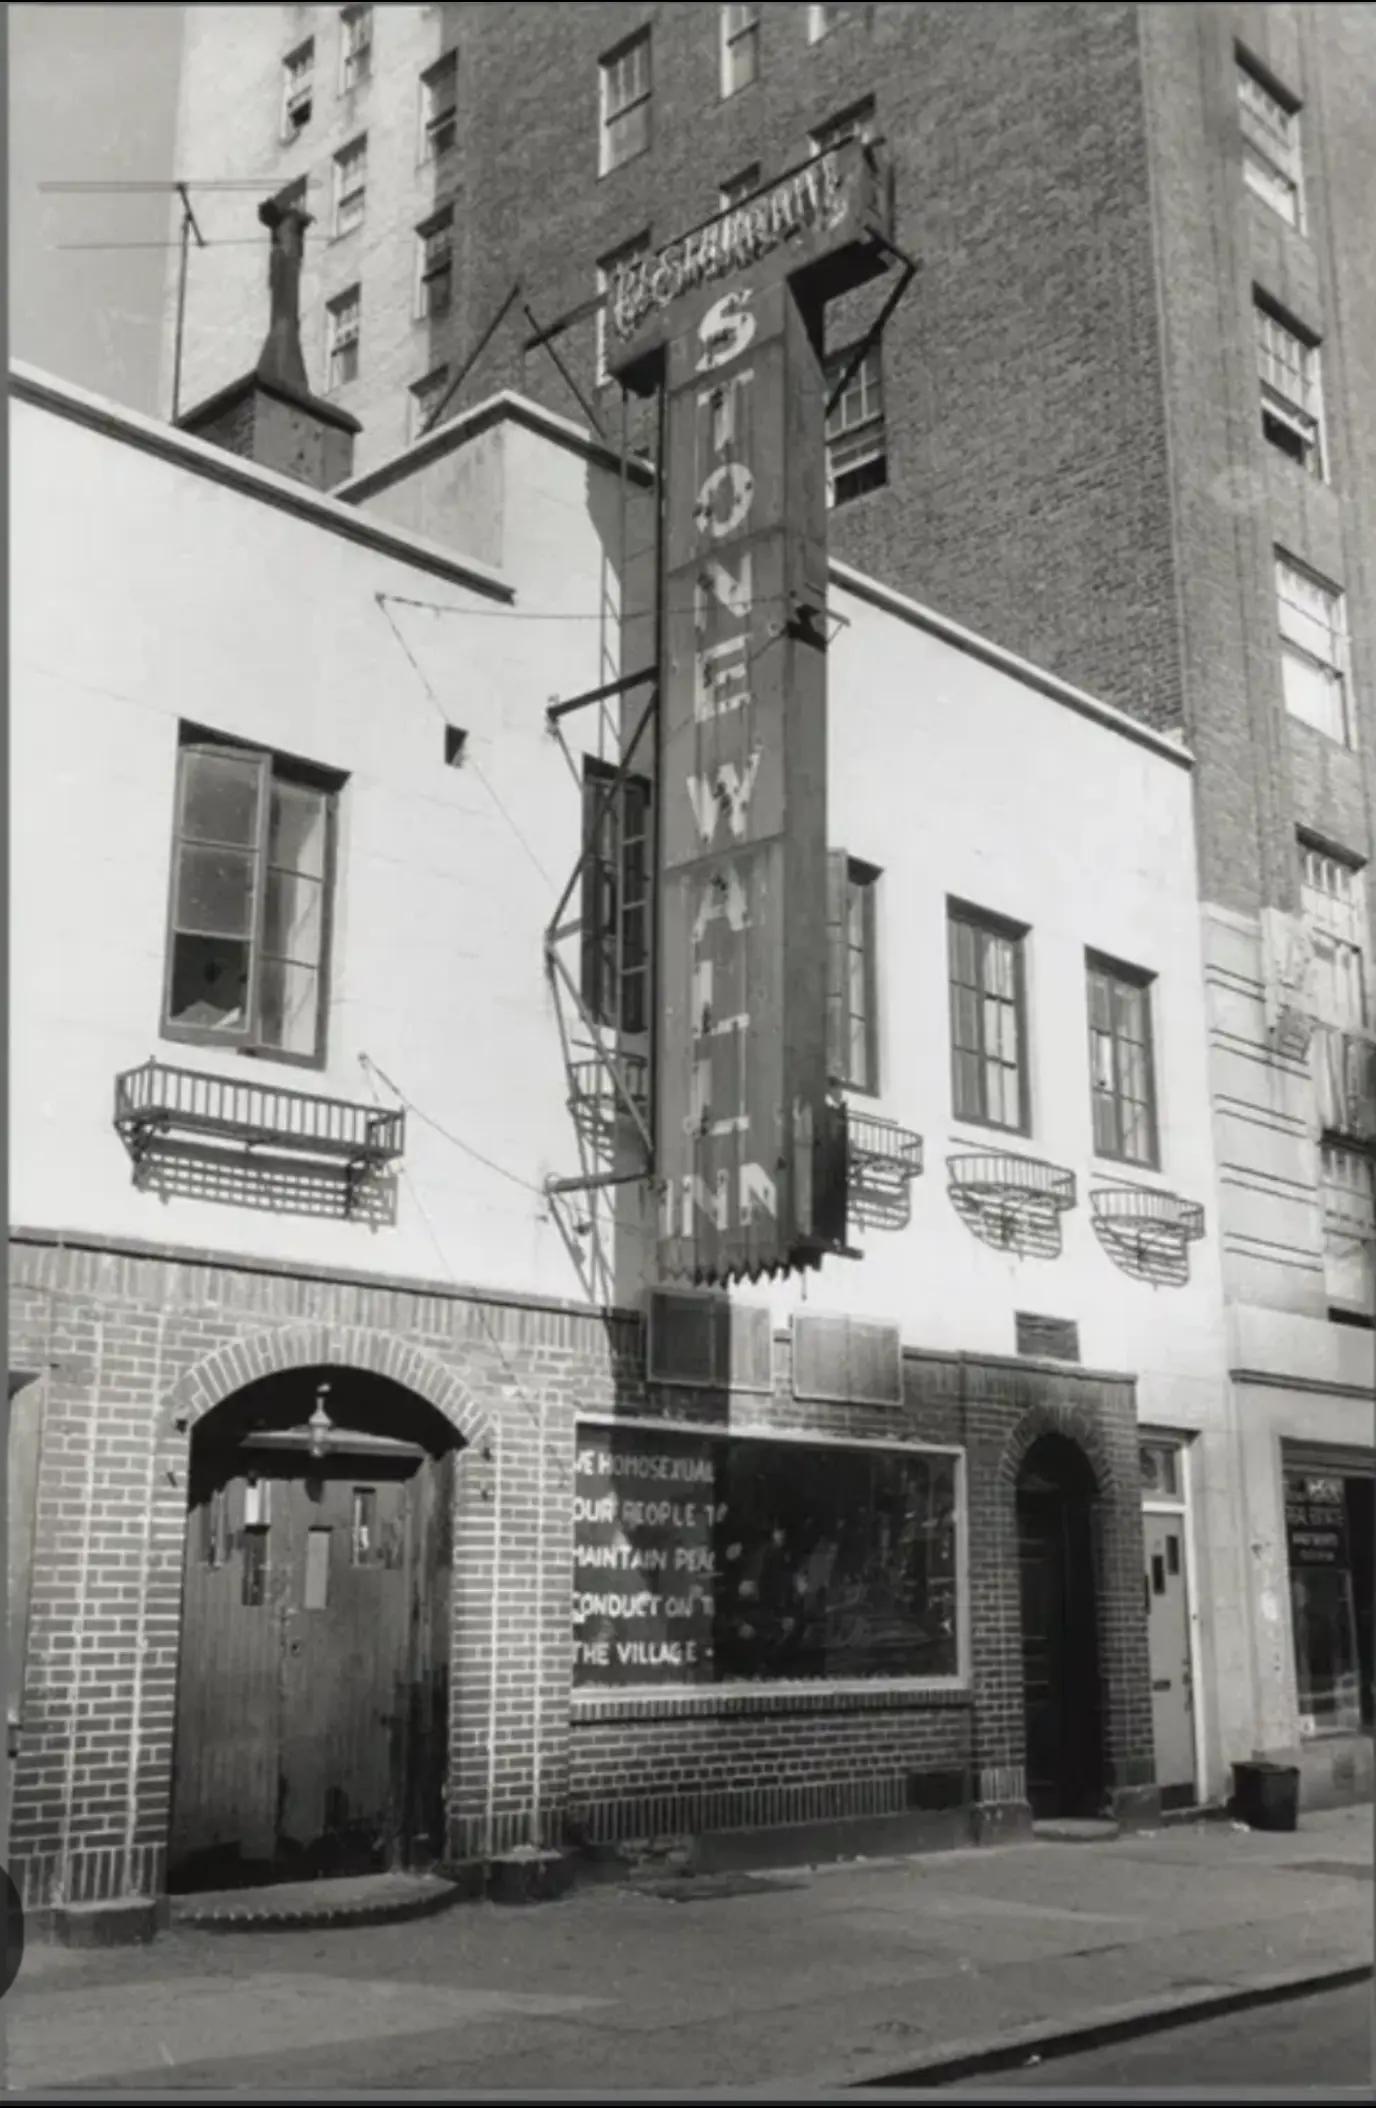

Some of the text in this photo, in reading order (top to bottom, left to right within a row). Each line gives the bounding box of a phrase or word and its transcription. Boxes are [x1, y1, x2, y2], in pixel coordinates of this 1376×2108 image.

[686, 288, 763, 1137] STONEWALL
[664, 1163, 778, 1237] INN
[572, 1497, 614, 1523] OUR
[623, 1501, 697, 1528] PEOPLE
[572, 1544, 668, 1570] MAINTAIN
[571, 1591, 661, 1622] CONDUCT
[571, 1641, 698, 1665] THE VILLAGE
